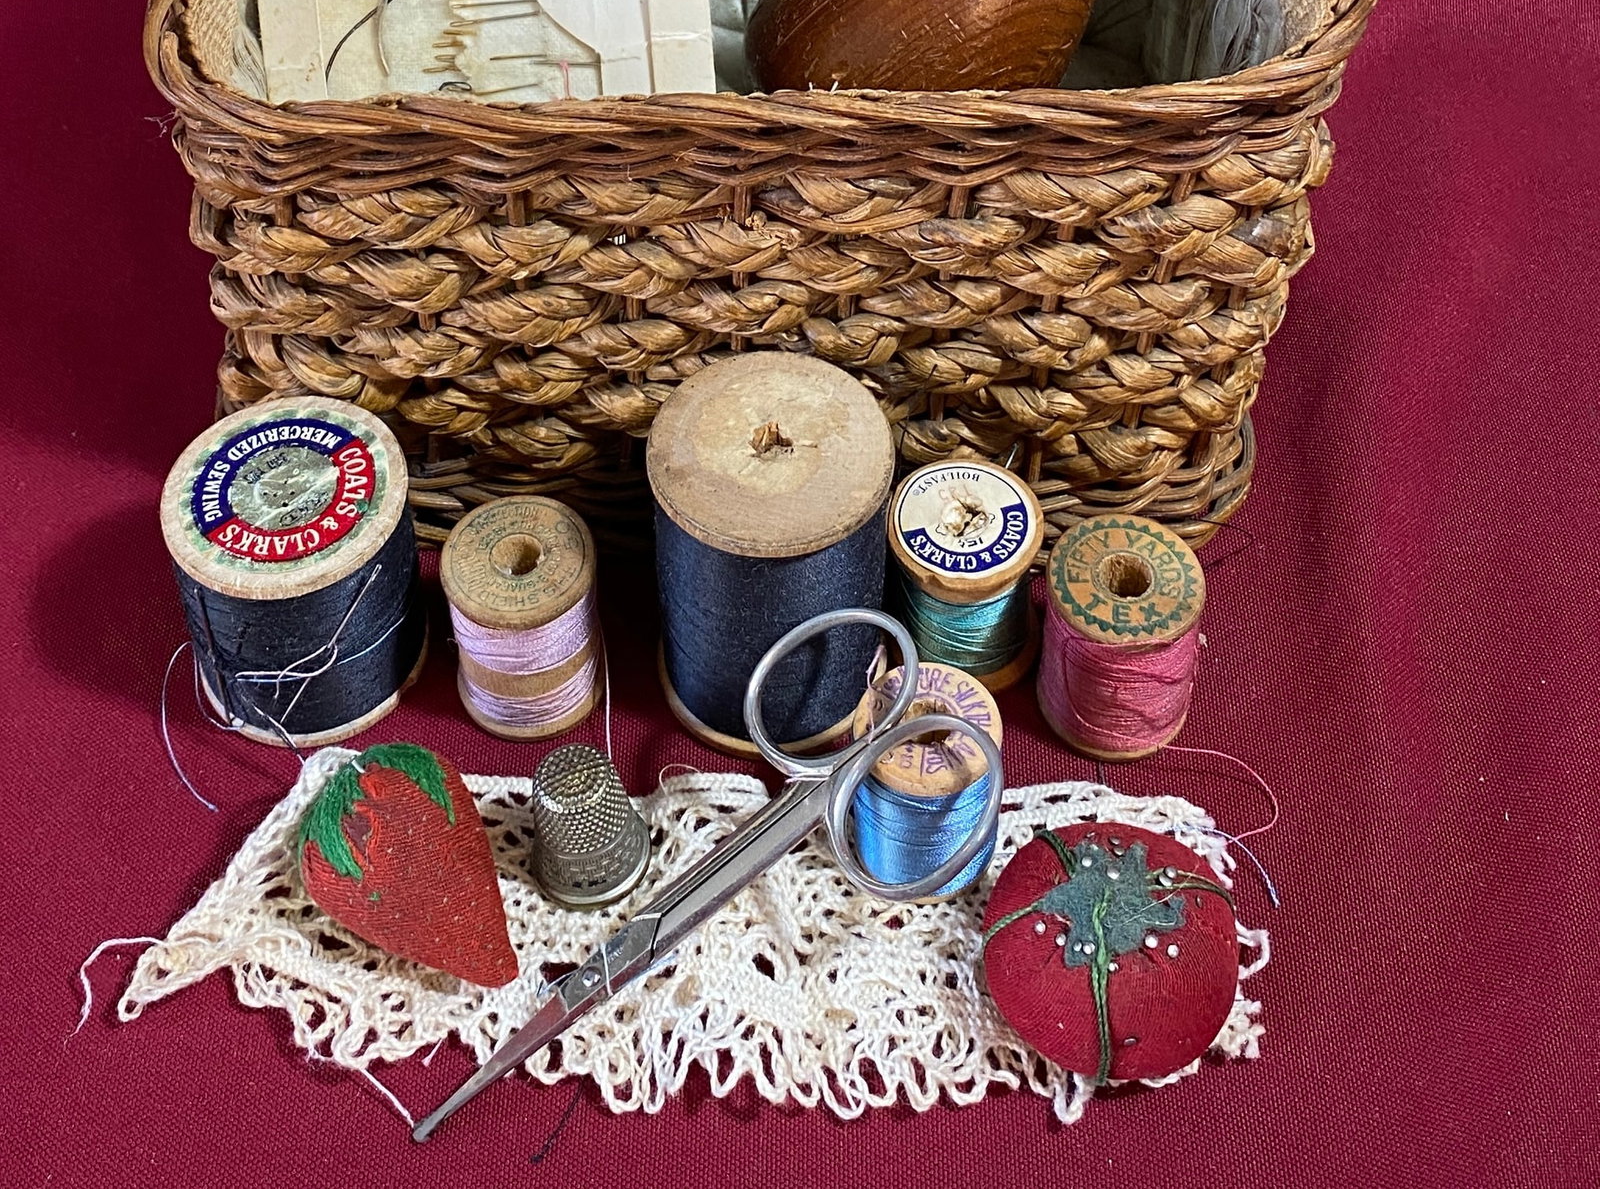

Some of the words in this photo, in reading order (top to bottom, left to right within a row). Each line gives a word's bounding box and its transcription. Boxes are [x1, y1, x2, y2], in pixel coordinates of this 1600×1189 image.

[226, 424, 343, 460] MERCERIZED
[203, 460, 231, 524] SEWING
[334, 446, 370, 518] COATS
[217, 522, 320, 556] CLARK'S
[319, 515, 339, 532] &
[992, 510, 1024, 561] COATS
[909, 533, 978, 570] CLARK'S
[979, 551, 992, 563] &
[1067, 530, 1110, 584] FIFTY
[1125, 530, 1182, 599] YARDS
[1085, 592, 1164, 624] TEX
